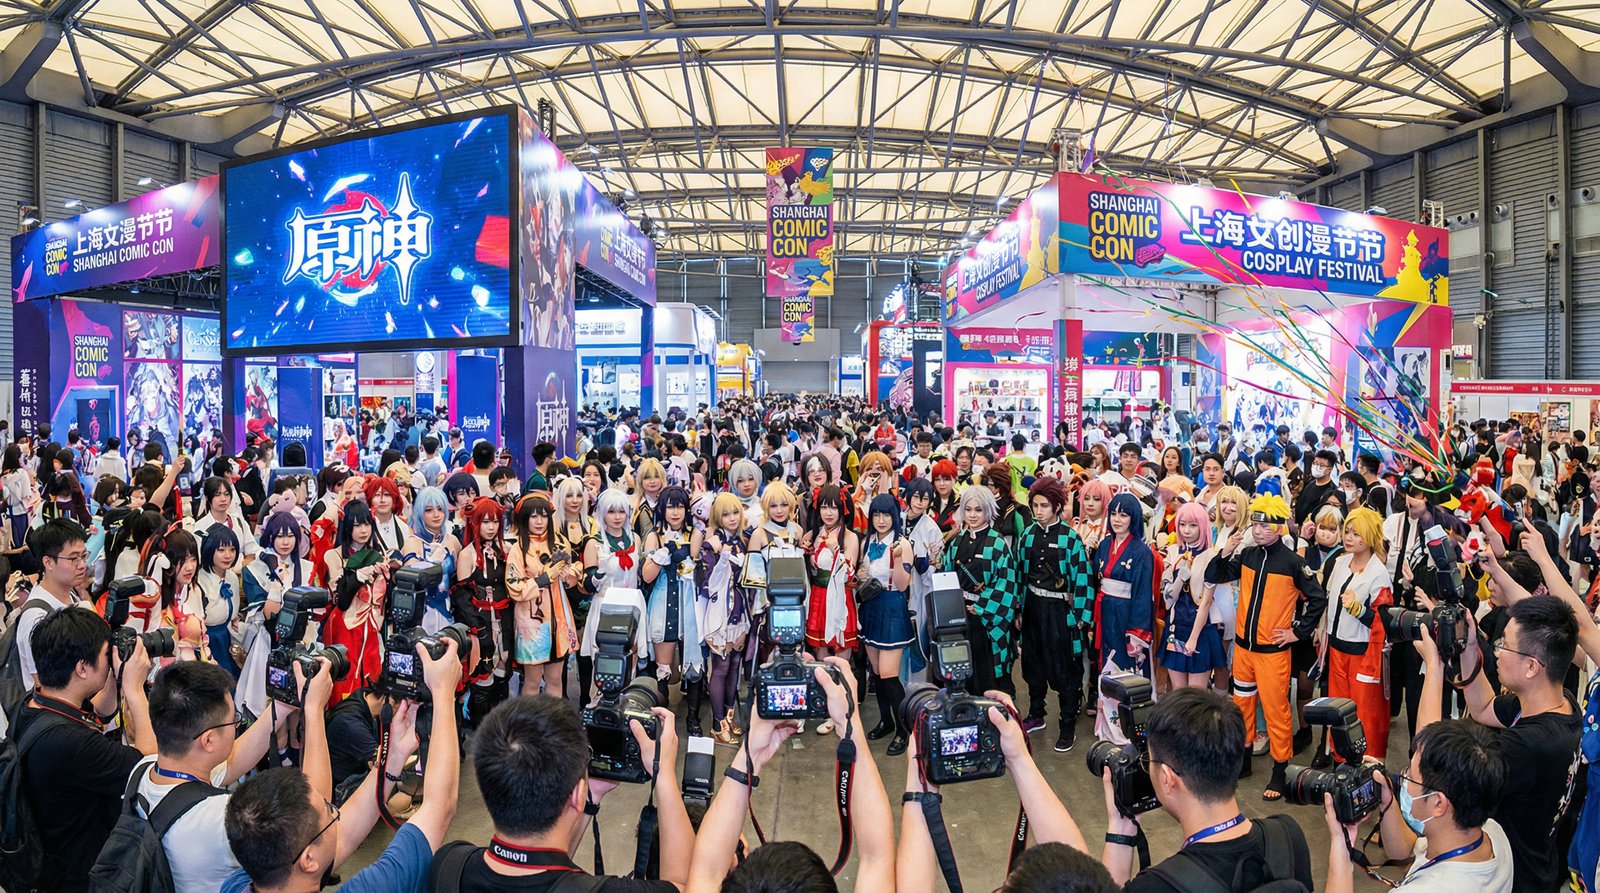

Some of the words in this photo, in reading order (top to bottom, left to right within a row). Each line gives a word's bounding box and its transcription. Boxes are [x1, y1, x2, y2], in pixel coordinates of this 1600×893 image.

[772, 206, 828, 219] SHANGHAI
[1090, 193, 1158, 214] SHANGHAI
[772, 219, 827, 237] COMIC
[1091, 211, 1158, 239] COMIC
[283, 173, 432, 303] 原神
[773, 238, 808, 256] CON
[45, 247, 68, 264] COMIC
[73, 250, 117, 273] SHANGHAI
[119, 243, 150, 263] COMIC
[152, 237, 174, 256] CON
[1091, 235, 1134, 260] CON
[46, 262, 60, 276] CON
[1243, 250, 1314, 276] COSPLAY
[1318, 259, 1384, 283] FESTIVAL
[784, 302, 812, 313] COMIC
[784, 312, 802, 322] CON
[74, 335, 109, 346] SHANGHAI
[75, 346, 109, 362] COMIC
[75, 362, 97, 377] CON
[494, 845, 528, 863] Canon
